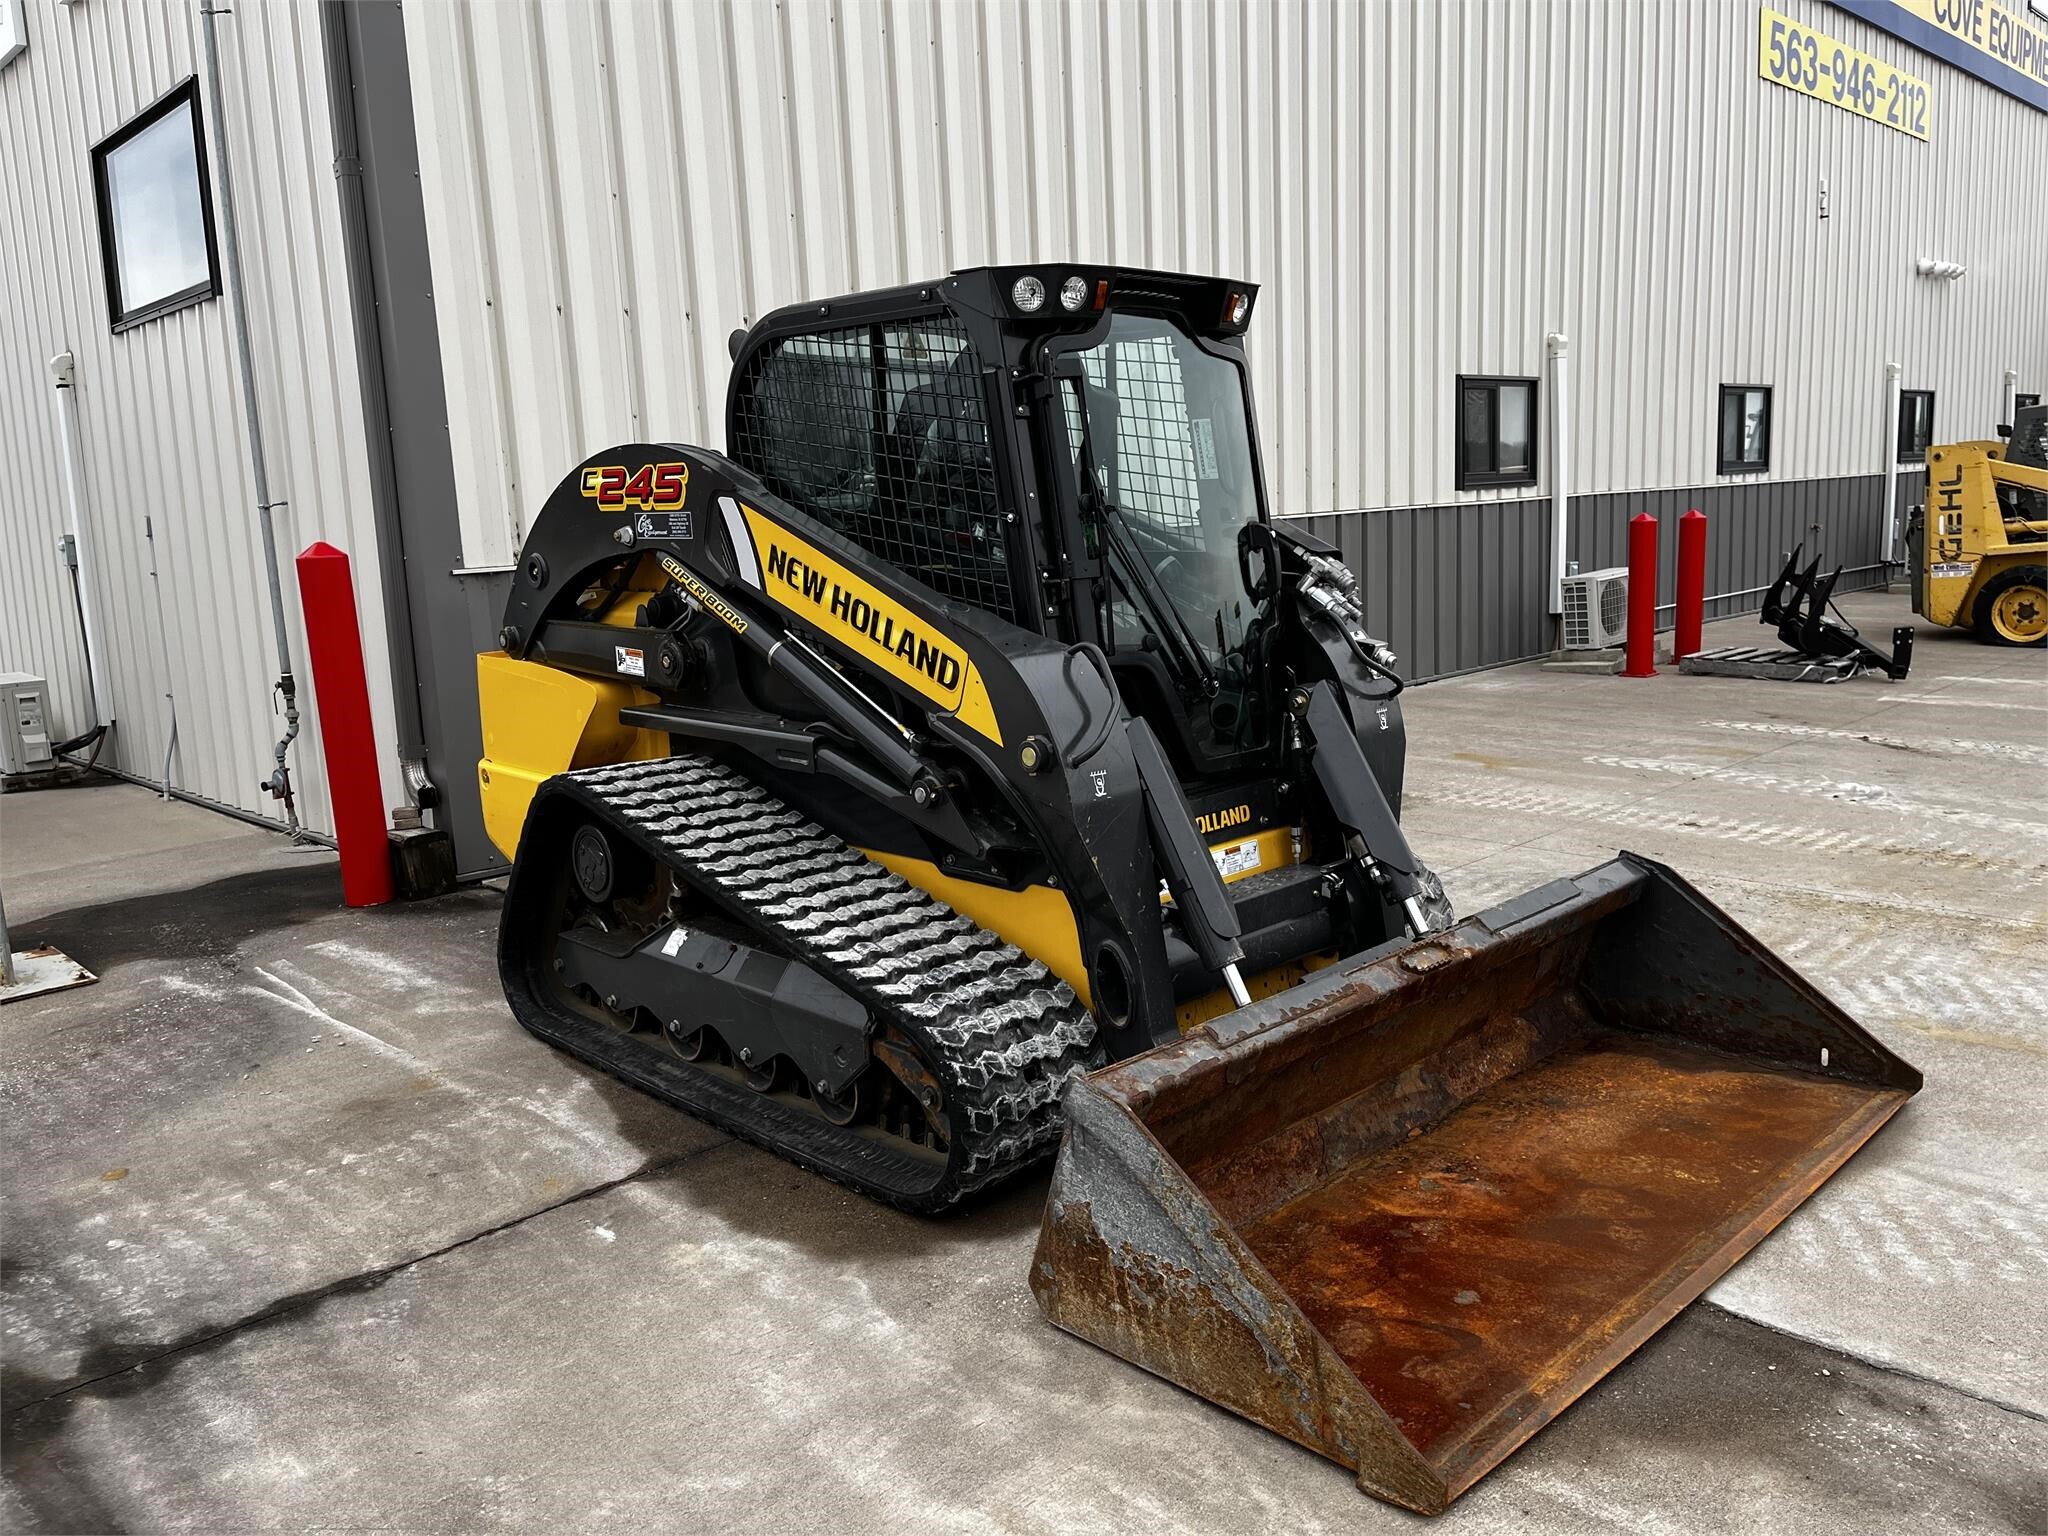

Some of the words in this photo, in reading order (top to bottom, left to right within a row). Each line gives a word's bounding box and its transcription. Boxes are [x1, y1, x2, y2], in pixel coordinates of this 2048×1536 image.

[1769, 20, 1926, 135] 563-946-2112
[580, 462, 689, 511] C245
[662, 557, 708, 600] SUPER
[704, 593, 748, 634] BOOM
[768, 544, 828, 606] NEW
[829, 585, 961, 692] HOLLAND
[1195, 804, 1251, 834] OLLAND
